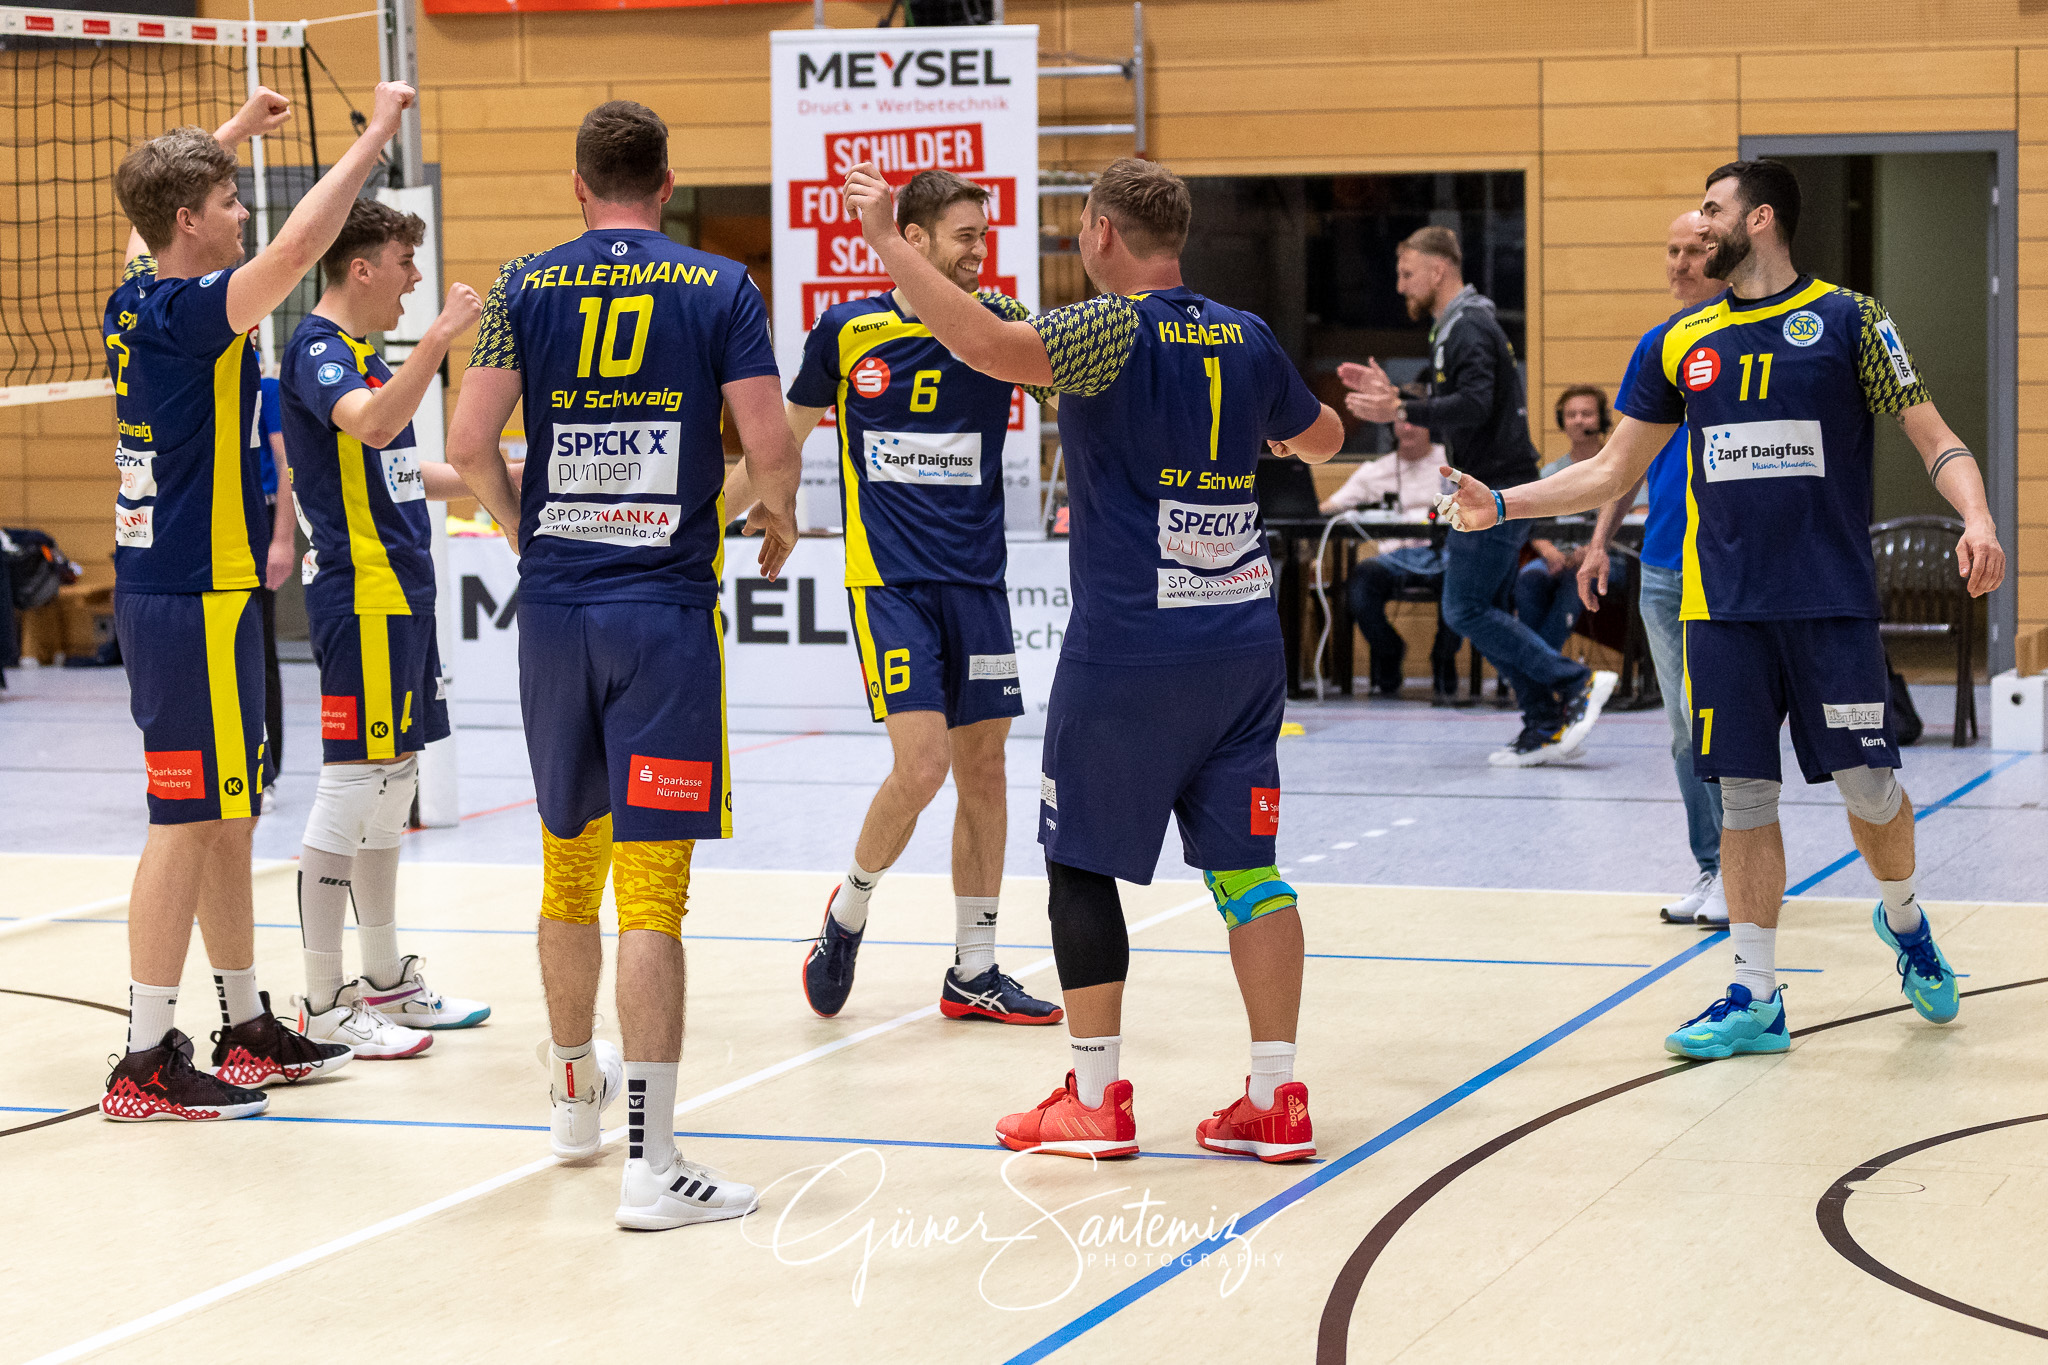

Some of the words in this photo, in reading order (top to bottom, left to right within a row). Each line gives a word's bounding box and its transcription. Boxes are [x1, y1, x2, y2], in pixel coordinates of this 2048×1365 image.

[798, 49, 1010, 88] MEYSEL
[799, 100, 852, 114] Druck
[877, 97, 1009, 113] Werbetechnik
[834, 130, 974, 176] SCHILDER
[521, 262, 718, 290] KELLERMANN
[853, 320, 888, 334] Kempa
[1684, 313, 1719, 329] Kempa
[577, 294, 654, 378] 10
[106, 334, 130, 396] 2
[1739, 353, 1773, 401] 11
[551, 391, 577, 408] SV
[584, 388, 683, 411] Schwaig
[909, 370, 942, 412] 6
[1203, 357, 1222, 460] 1
[557, 430, 641, 457] SPECK
[1717, 446, 1748, 462] Zapf
[1751, 443, 1815, 459] Daigfuss
[883, 454, 915, 468] Zapf
[918, 454, 973, 468] Daigfuss
[1159, 469, 1192, 487] SV
[1168, 508, 1239, 537] SPECK
[884, 648, 911, 695] 6
[656, 787, 699, 800] Nürnberg
[657, 774, 703, 787] Sparkasse
[1287, 1094, 1299, 1127] adidas
